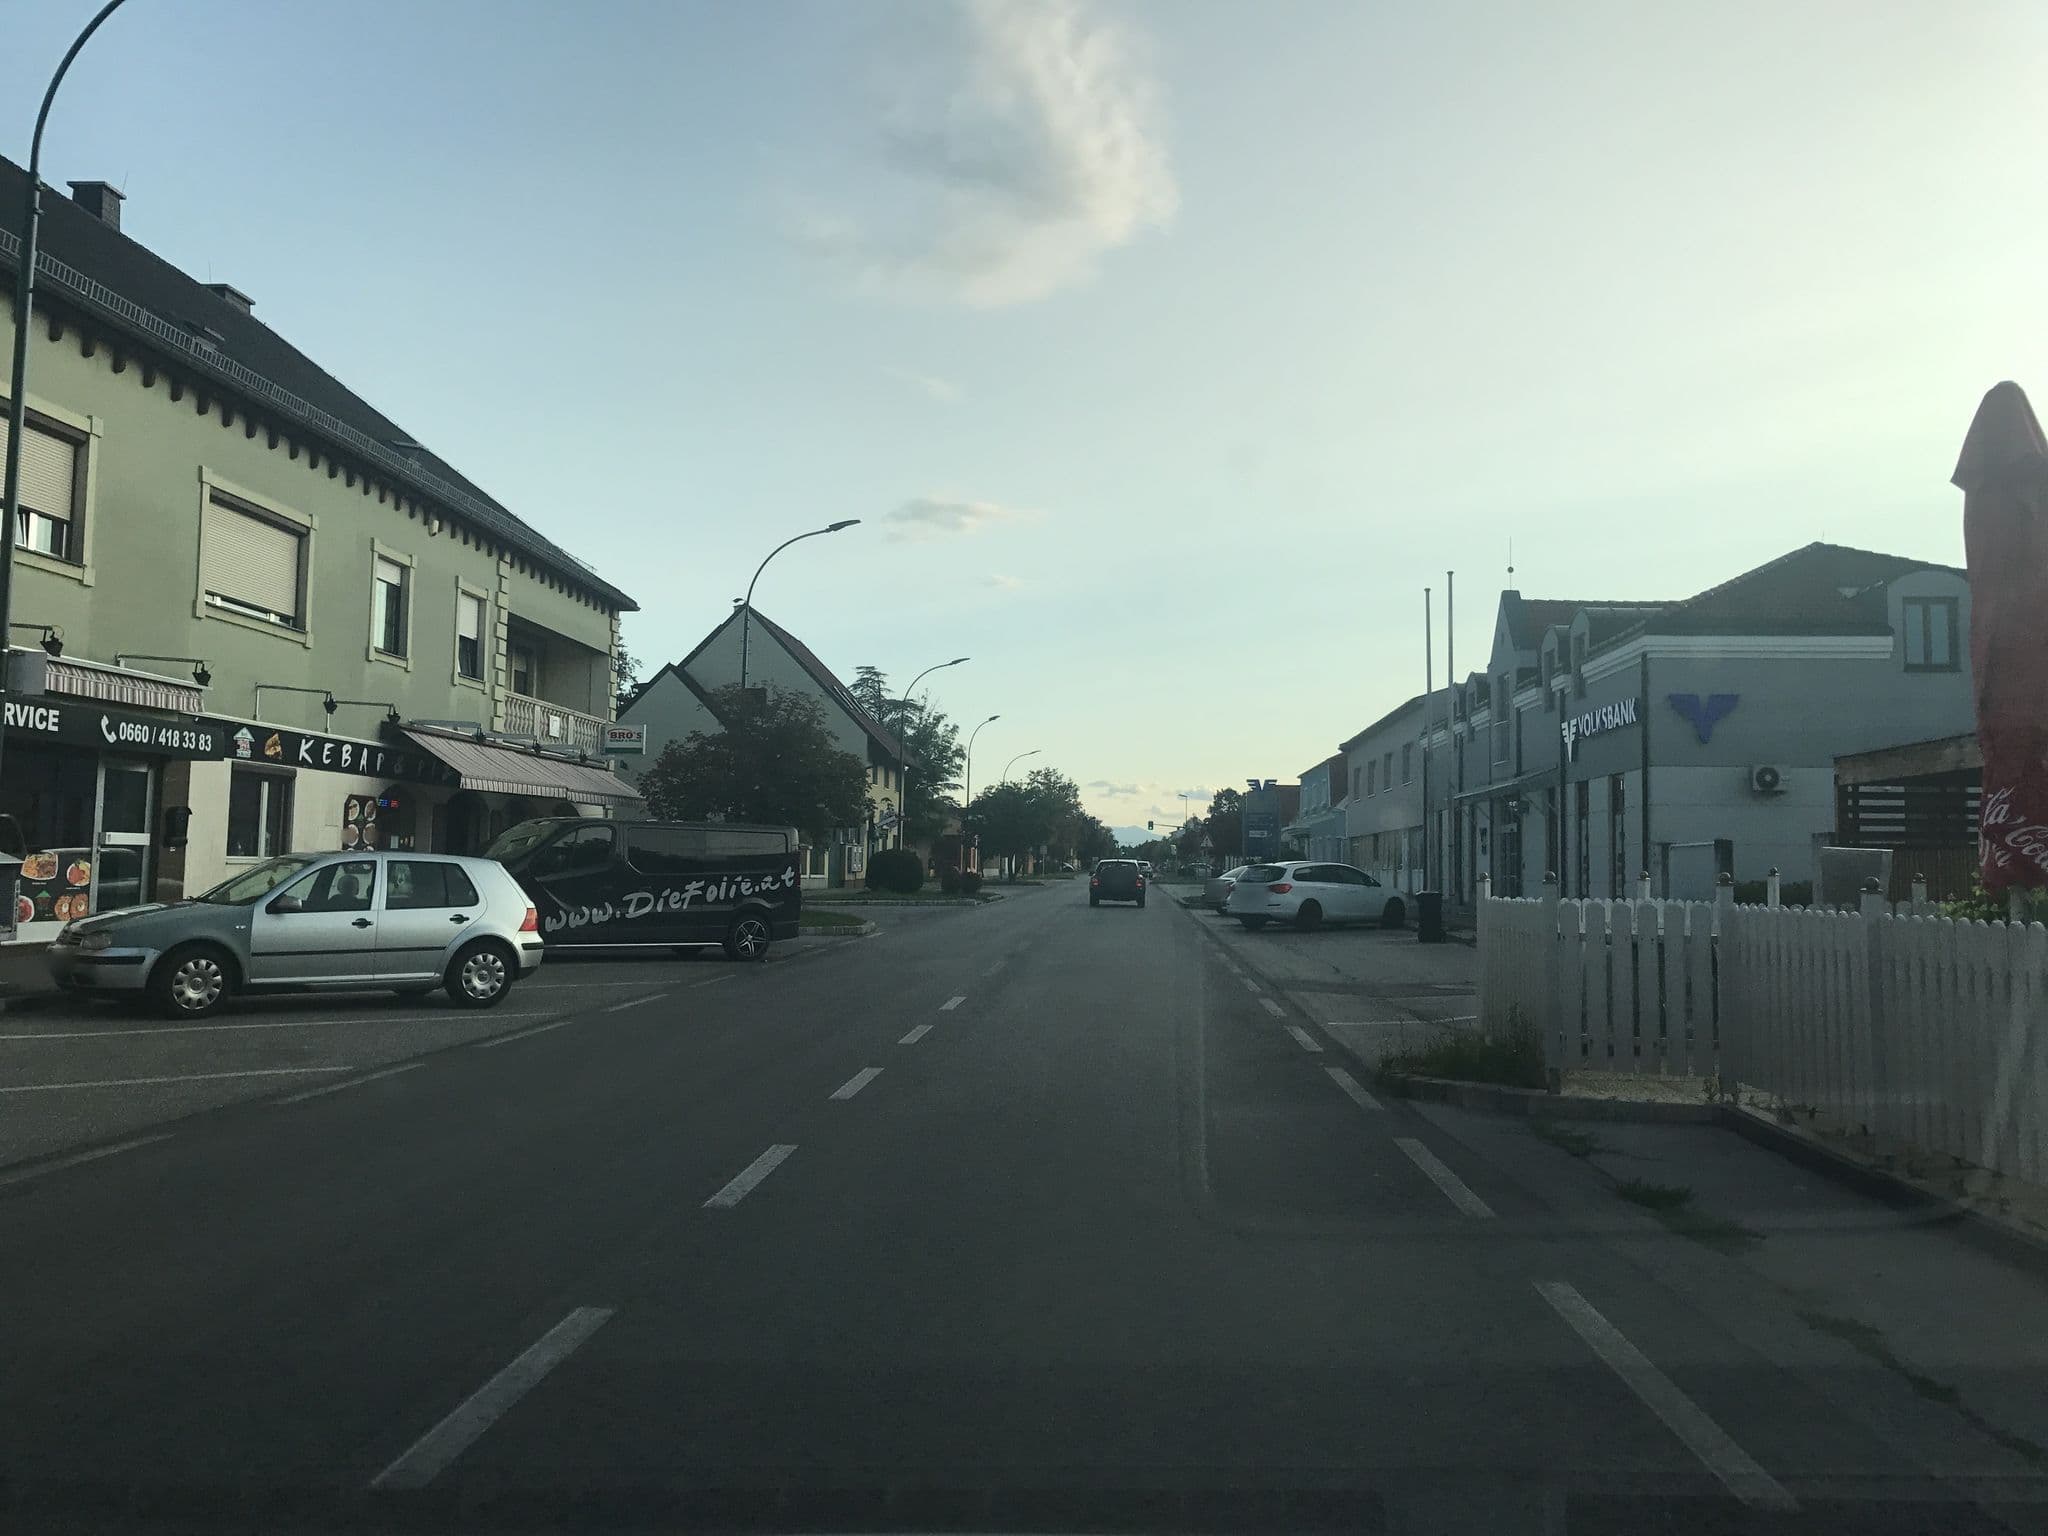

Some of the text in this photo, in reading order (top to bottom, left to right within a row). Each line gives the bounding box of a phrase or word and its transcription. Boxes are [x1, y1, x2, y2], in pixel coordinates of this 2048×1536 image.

[3, 702, 61, 732] RVICE
[1577, 697, 1637, 737] VOLKSBANK
[118, 721, 149, 744] 0660
[158, 728, 181, 748] 418
[181, 731, 197, 750] 33
[198, 733, 212, 752] 83
[609, 731, 642, 739] BRO'S
